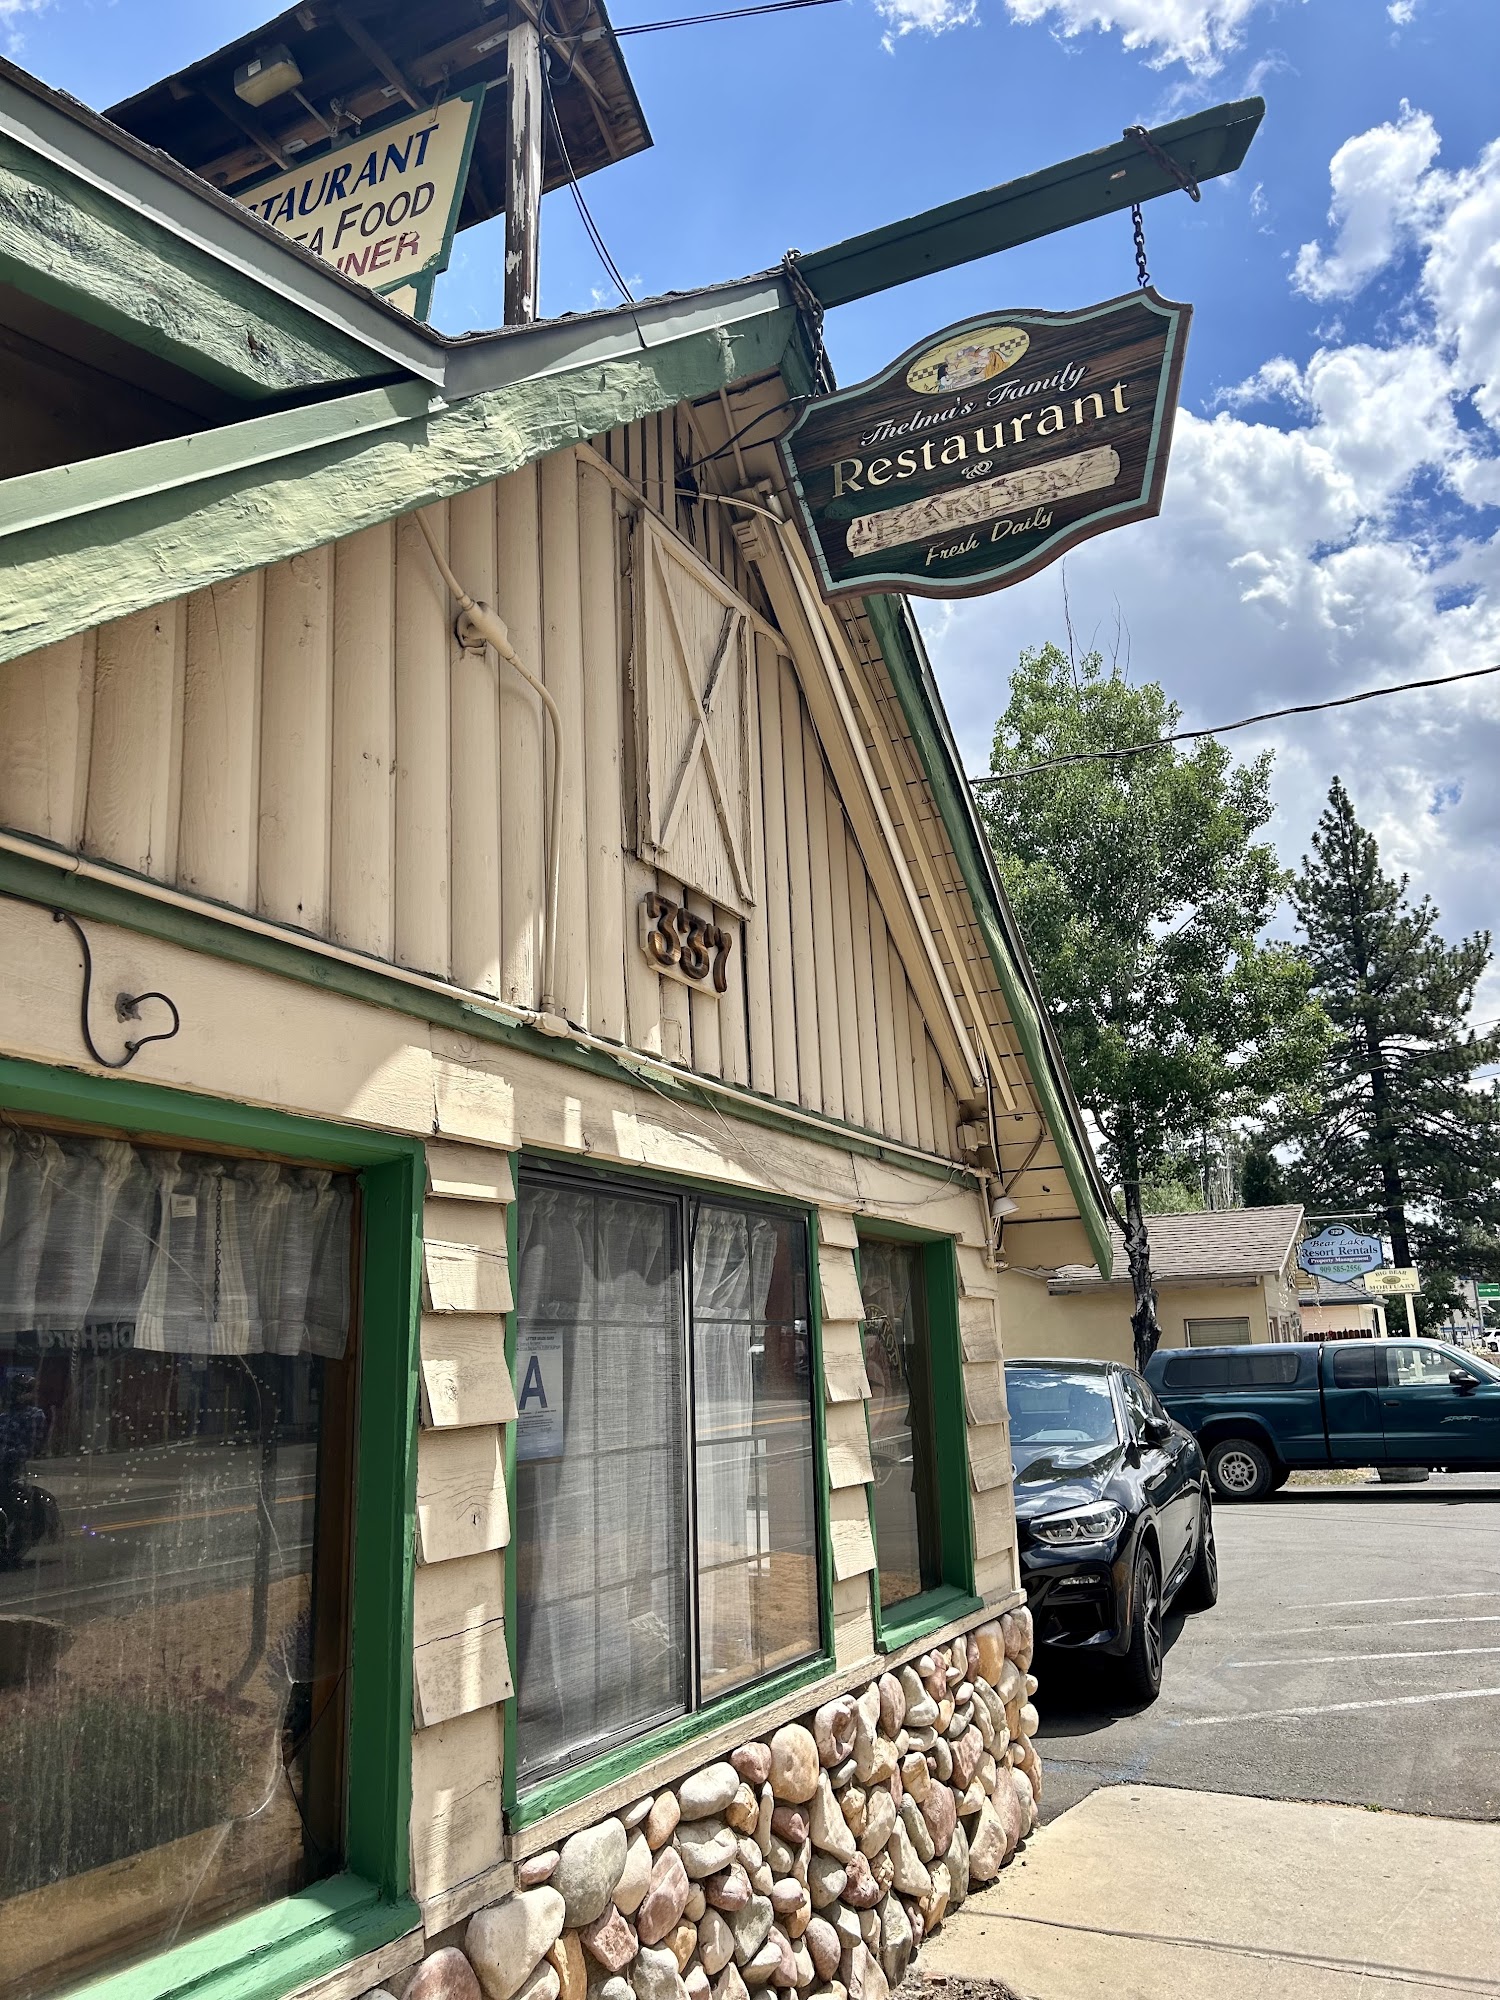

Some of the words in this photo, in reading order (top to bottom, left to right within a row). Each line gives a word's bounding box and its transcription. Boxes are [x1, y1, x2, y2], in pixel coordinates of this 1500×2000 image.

[248, 124, 439, 226] TAURANT
[332, 181, 435, 250] FOOD
[860, 396, 977, 447] Thelma's
[986, 361, 1087, 407] Family
[830, 380, 1131, 498] Restaurant
[924, 534, 980, 566] Fresh
[990, 507, 1054, 543] Daily
[645, 891, 732, 993] 337
[1302, 1248, 1334, 1257] Resort
[1338, 1245, 1378, 1255] Rentals
[1340, 1237, 1365, 1246] Lake
[518, 1355, 548, 1410] A
